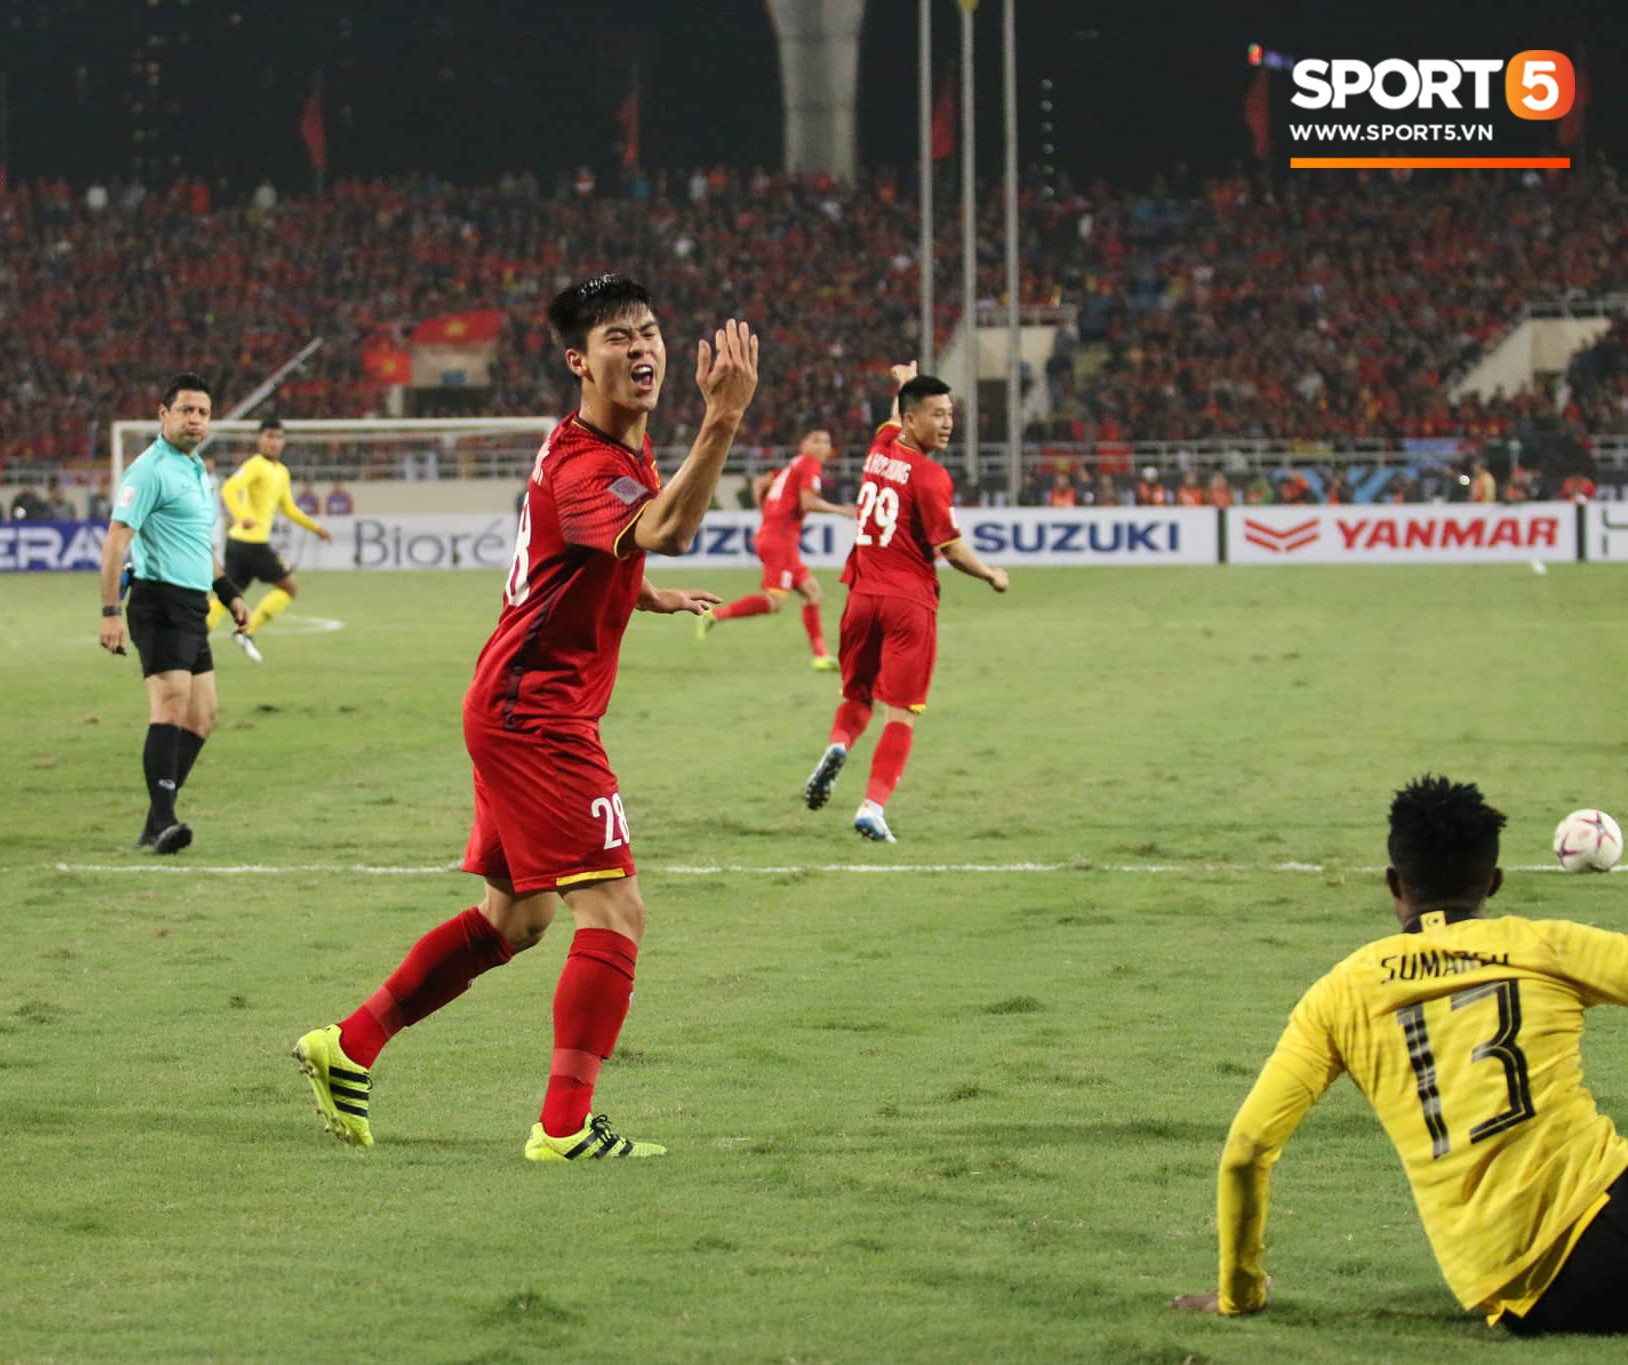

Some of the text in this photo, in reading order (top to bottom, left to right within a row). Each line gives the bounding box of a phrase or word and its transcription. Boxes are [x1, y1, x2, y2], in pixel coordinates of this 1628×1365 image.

[857, 481, 900, 547] 29
[972, 520, 1180, 553] SUZUKI
[1336, 517, 1559, 550] YANMAR
[354, 518, 505, 567] Bioré
[591, 792, 630, 850] 28
[1396, 976, 1537, 1160] 13
